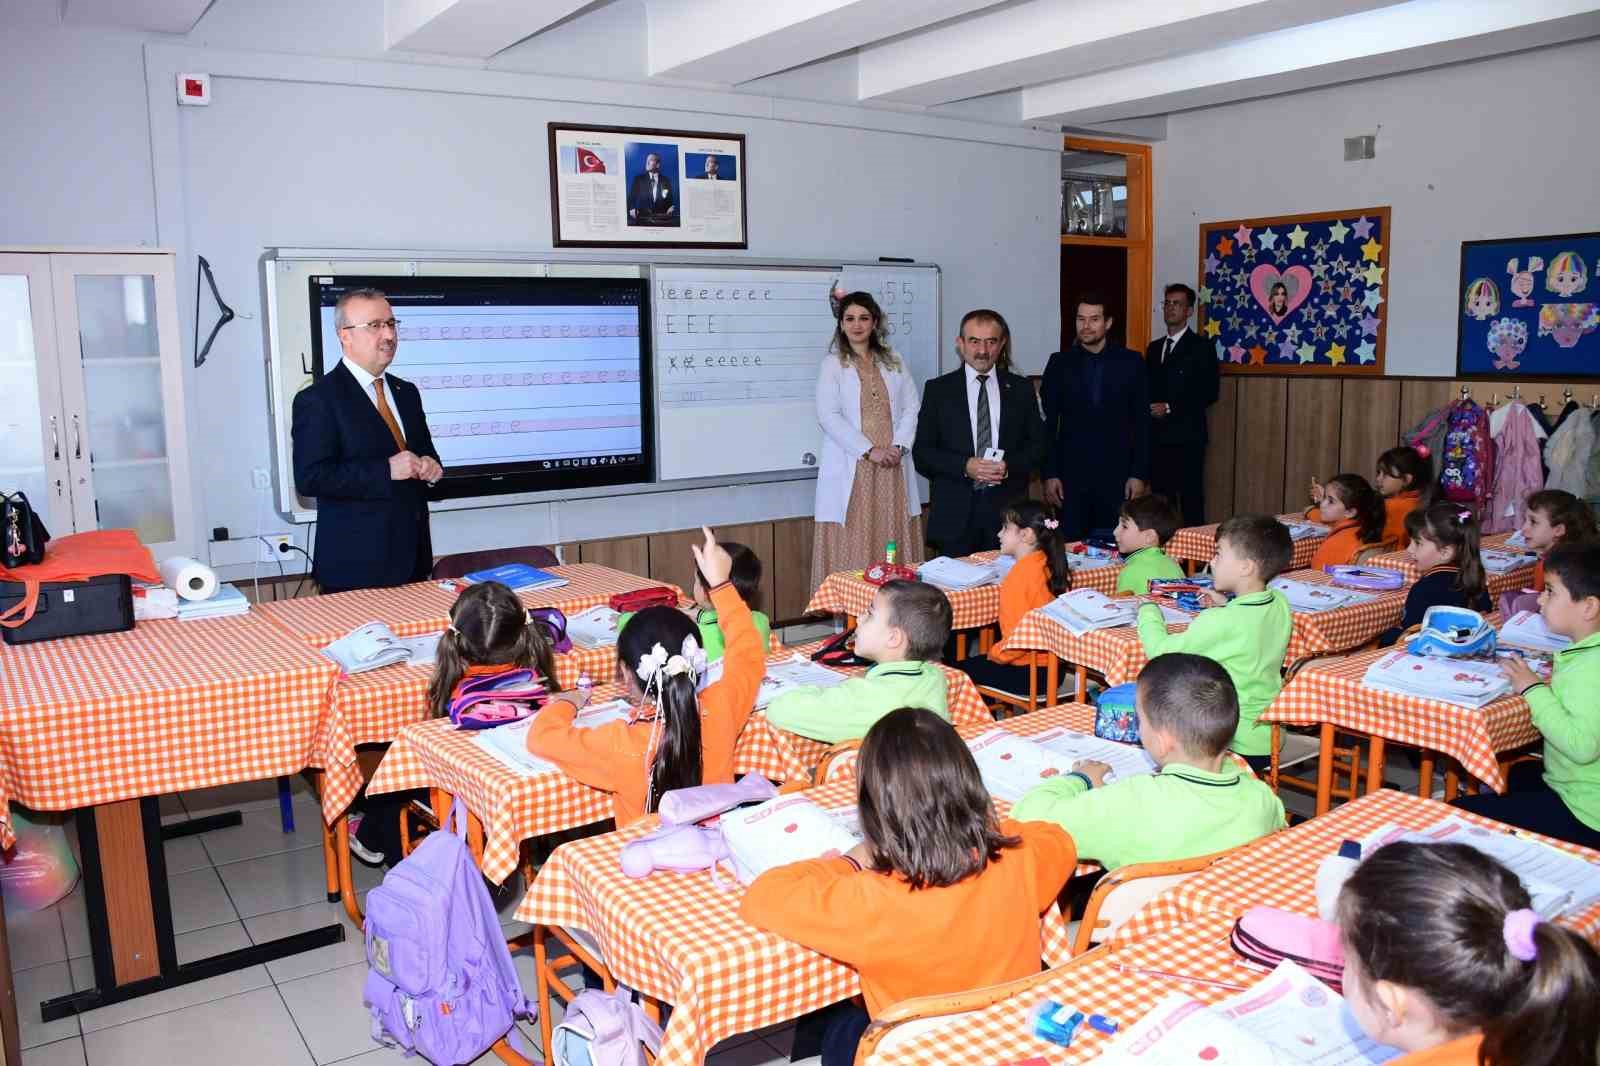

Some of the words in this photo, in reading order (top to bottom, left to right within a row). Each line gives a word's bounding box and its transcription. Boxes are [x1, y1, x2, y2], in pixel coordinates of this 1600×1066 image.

[699, 288, 709, 300] e
[903, 282, 914, 305] 5
[666, 314, 680, 334] E
[687, 314, 698, 334] E
[708, 314, 720, 334] E
[902, 312, 913, 336] 5
